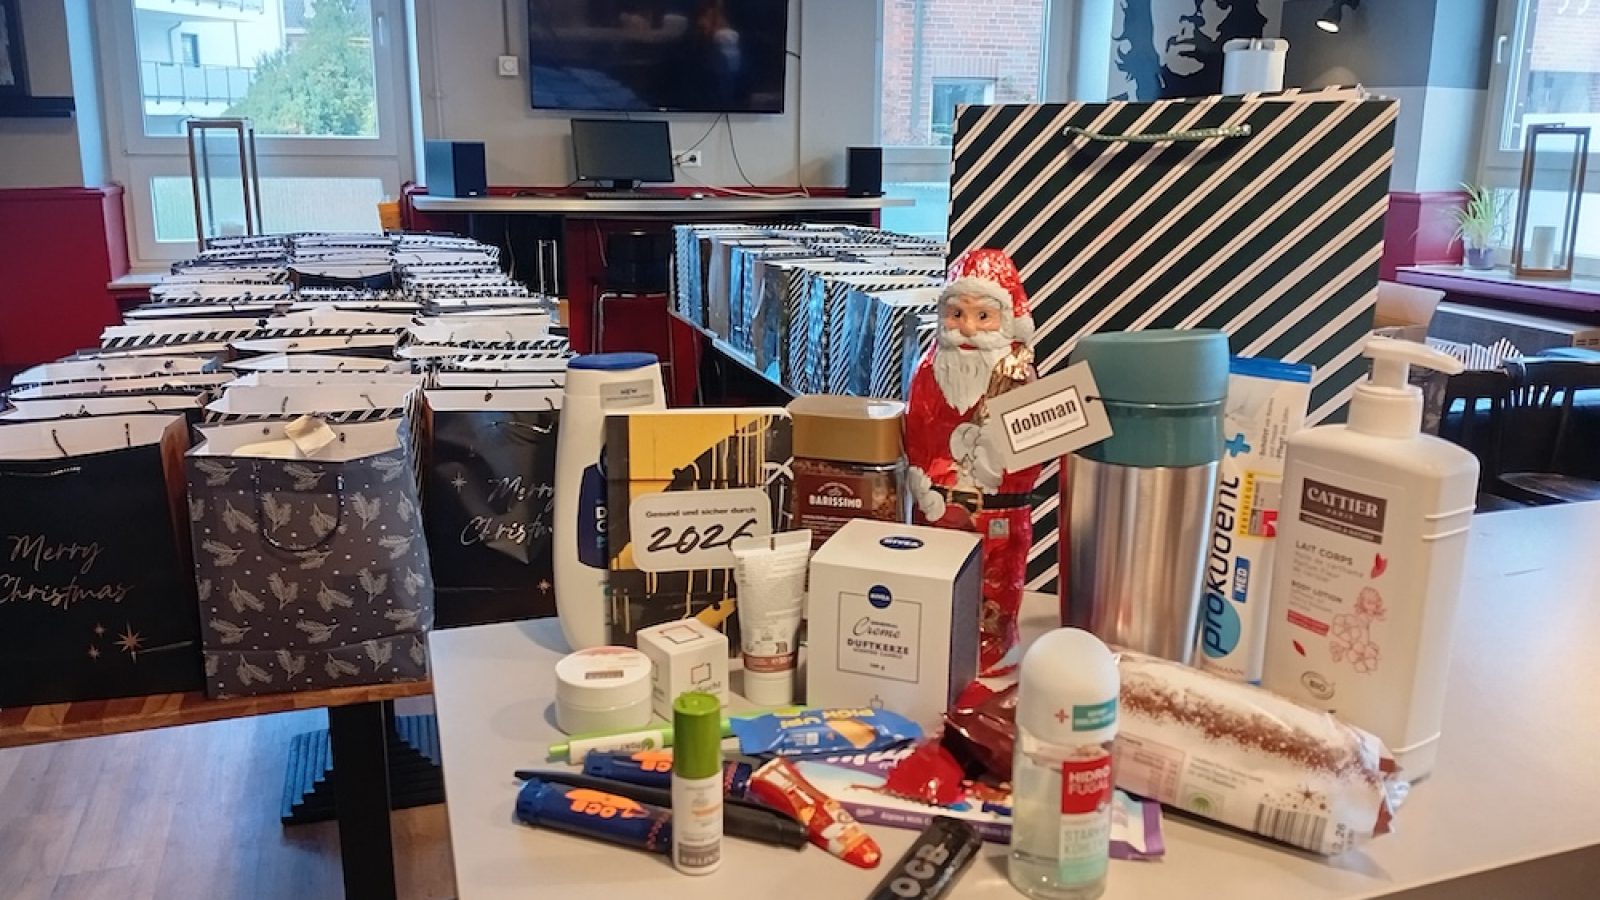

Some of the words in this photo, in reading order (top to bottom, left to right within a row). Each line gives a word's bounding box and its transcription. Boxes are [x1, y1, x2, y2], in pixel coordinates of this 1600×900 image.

[1010, 399, 1078, 436] dobman
[646, 510, 681, 518] Gesund
[701, 507, 729, 515] sicher
[731, 506, 757, 514] durch
[808, 494, 863, 509] BARISSIMO
[1307, 487, 1378, 518] CATTIER
[8, 534, 105, 575] Merry
[1319, 547, 1353, 566] CORPS
[853, 616, 901, 639] Creme
[847, 638, 909, 655] DUFTKERZE
[1068, 765, 1111, 784] HIDRO
[890, 843, 950, 898] OCB
